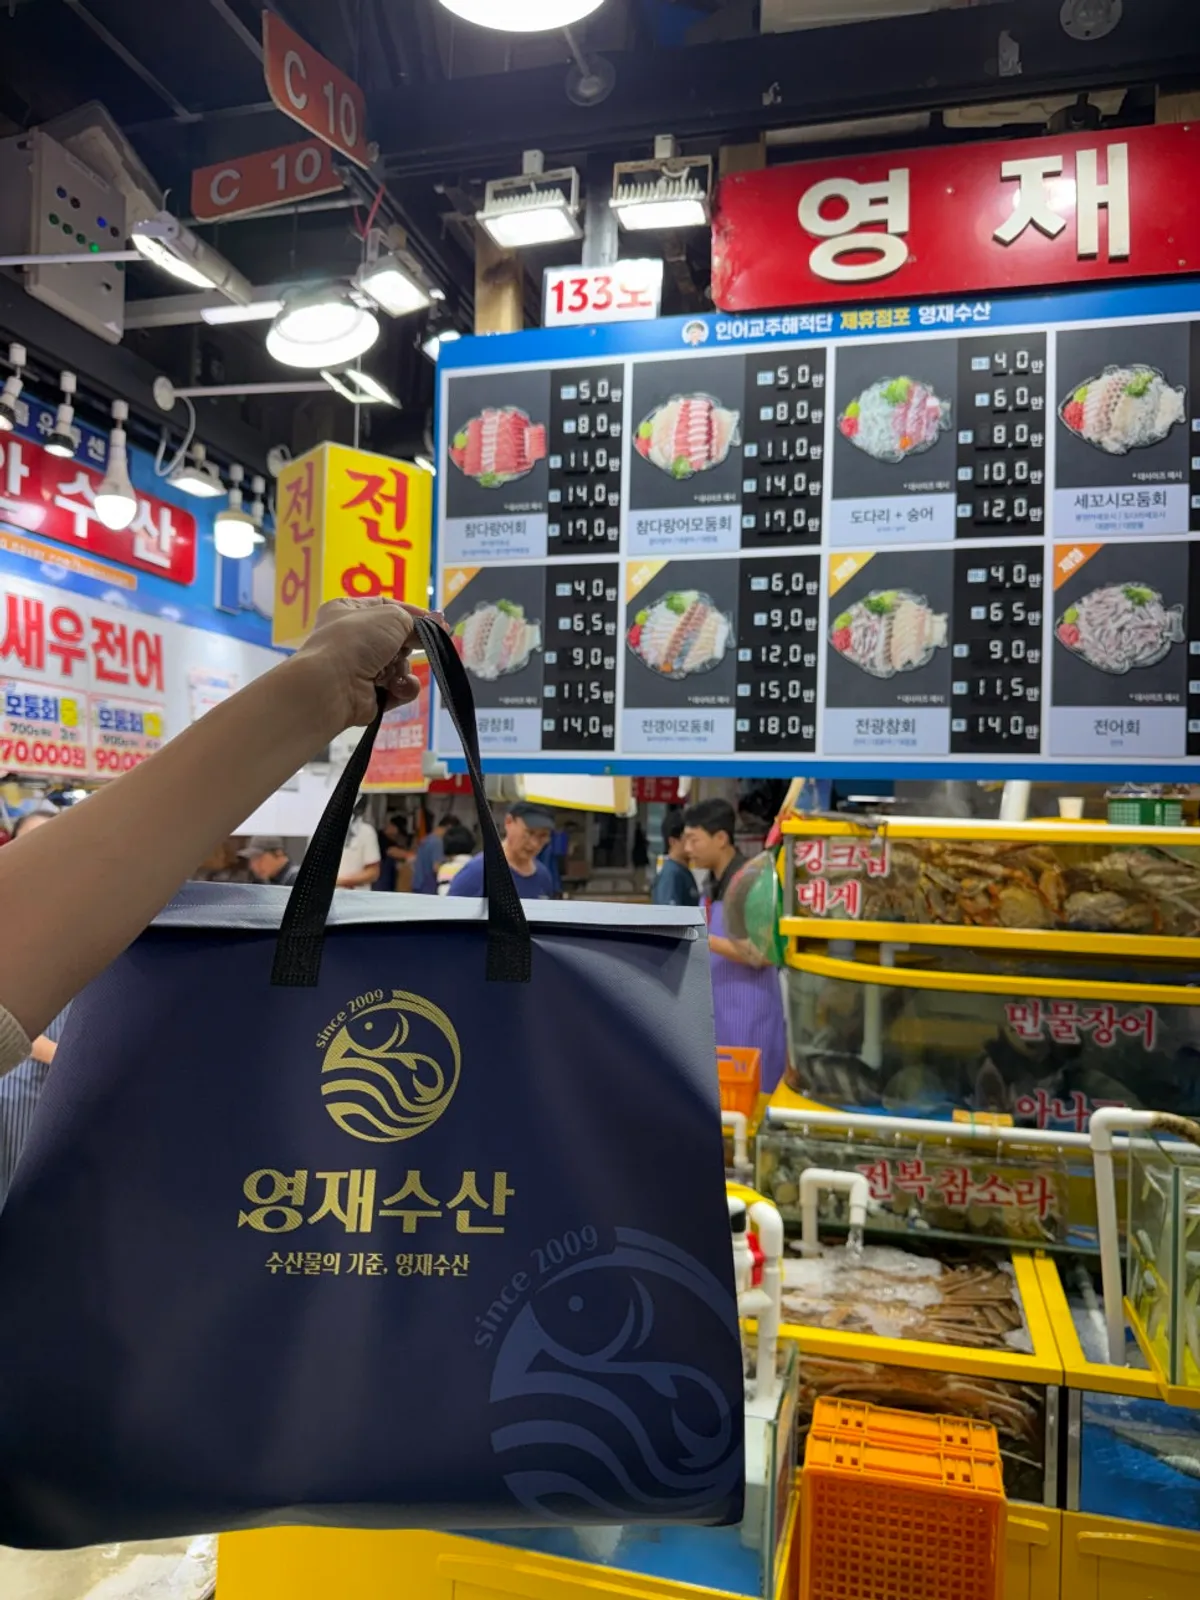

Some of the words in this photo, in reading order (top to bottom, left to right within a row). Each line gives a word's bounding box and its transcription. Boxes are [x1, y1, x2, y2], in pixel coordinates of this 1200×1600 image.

[284, 50, 308, 110] C
[323, 81, 358, 148] 10
[209, 168, 241, 206] C
[270, 147, 323, 191] 10
[715, 313, 834, 341] 인어교주해적단
[839, 307, 911, 330] 제휴점포
[918, 302, 992, 326] 영재수산
[850, 508, 890, 525] 도다리
[907, 506, 934, 523] 숭어
[1073, 490, 1167, 510] 세꼬시모둠회
[281, 460, 316, 630] 전어
[340, 466, 413, 602] 전어
[464, 519, 527, 539] 참다랑어회
[636, 514, 733, 536] 참다랑어모둠회
[1094, 719, 1141, 737] 전어회
[796, 877, 862, 919] 대게
[315, 1010, 348, 1049] since
[346, 988, 384, 1013] 2009
[1004, 998, 1157, 1052] 민물장어
[237, 1168, 516, 1234] 영재수산
[264, 1251, 341, 1276] 수산물의
[345, 1252, 389, 1276] 기준,
[395, 1252, 471, 1278] 영재수산
[474, 1269, 531, 1349] since
[529, 1224, 598, 1274] 2009
